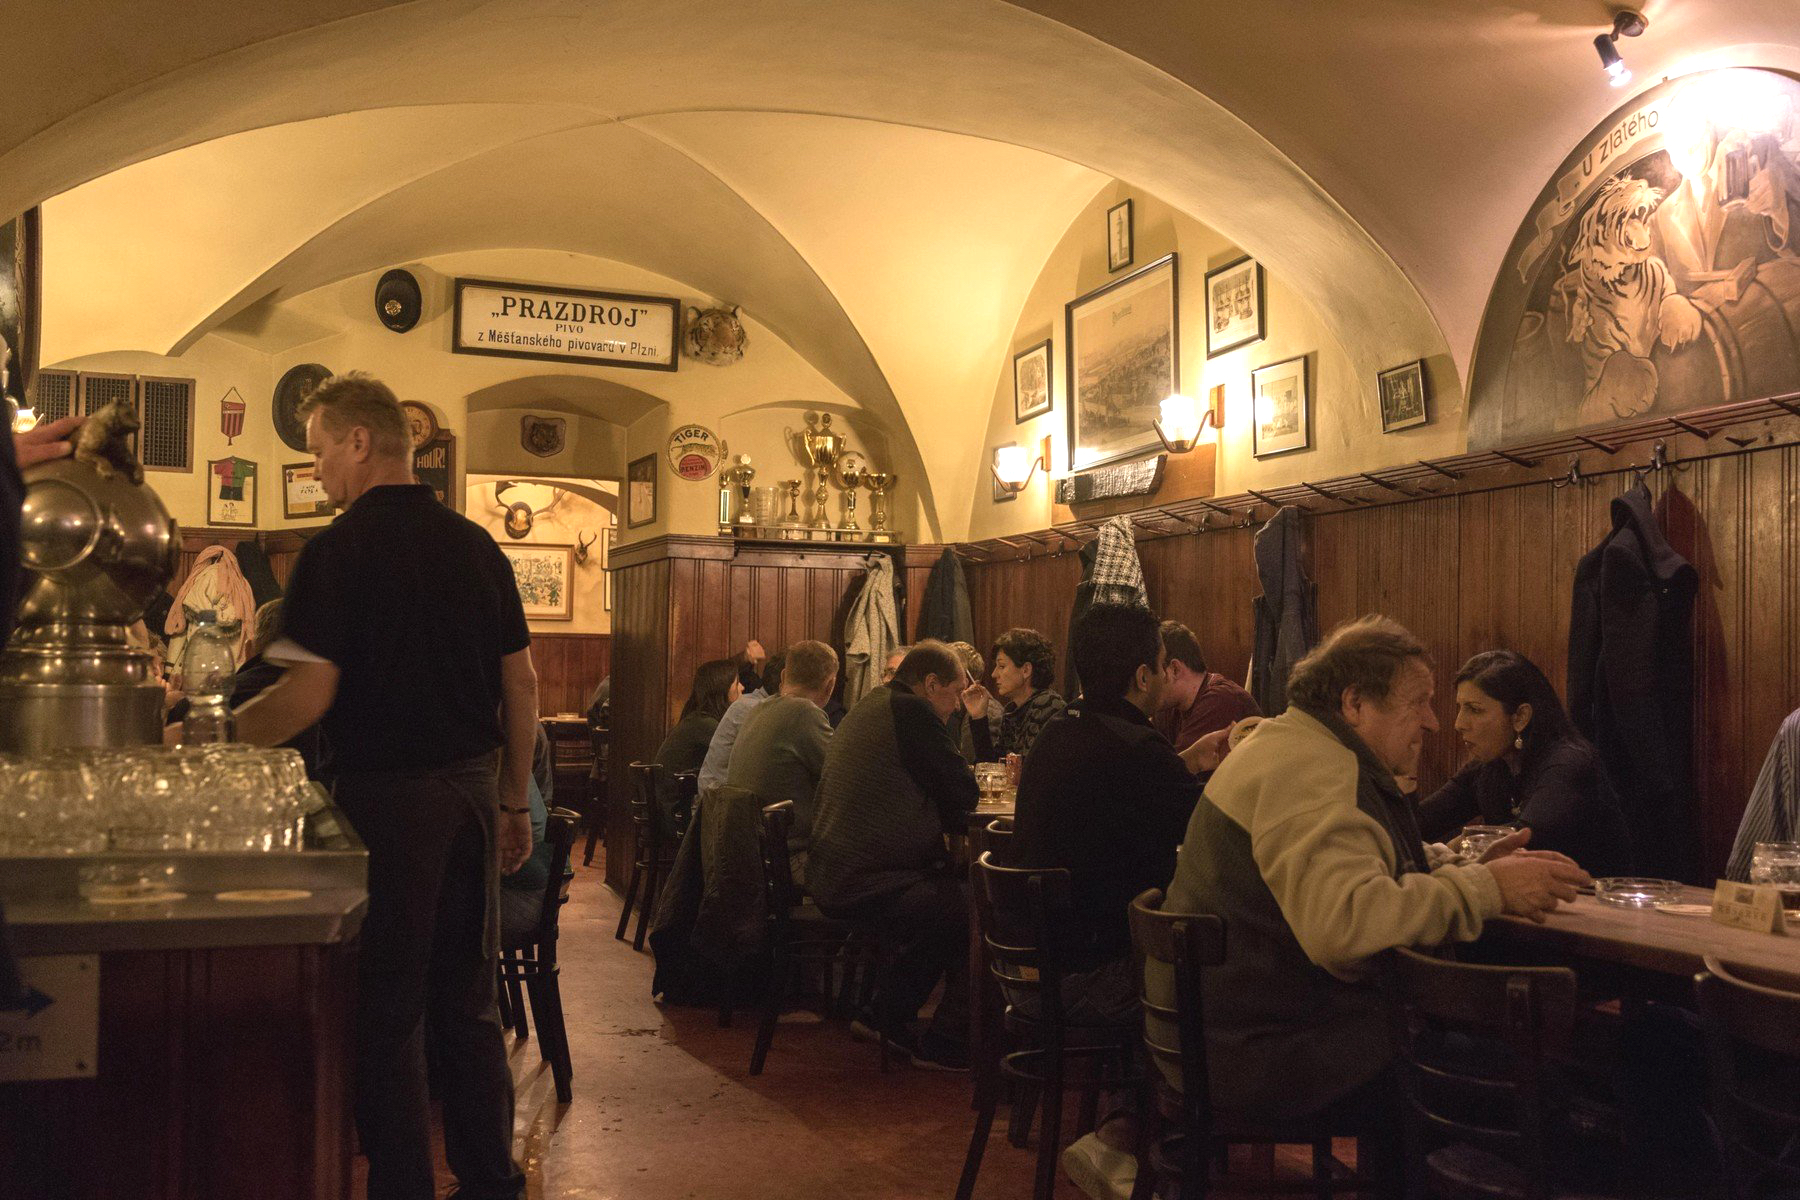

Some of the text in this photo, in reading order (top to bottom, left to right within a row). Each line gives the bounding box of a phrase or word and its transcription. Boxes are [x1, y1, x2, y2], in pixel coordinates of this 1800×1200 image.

[555, 323, 584, 334] PIVO
[478, 331, 484, 342] z
[619, 344, 626, 354] v
[674, 429, 709, 444] TIGER
[416, 447, 446, 469] HOUR!
